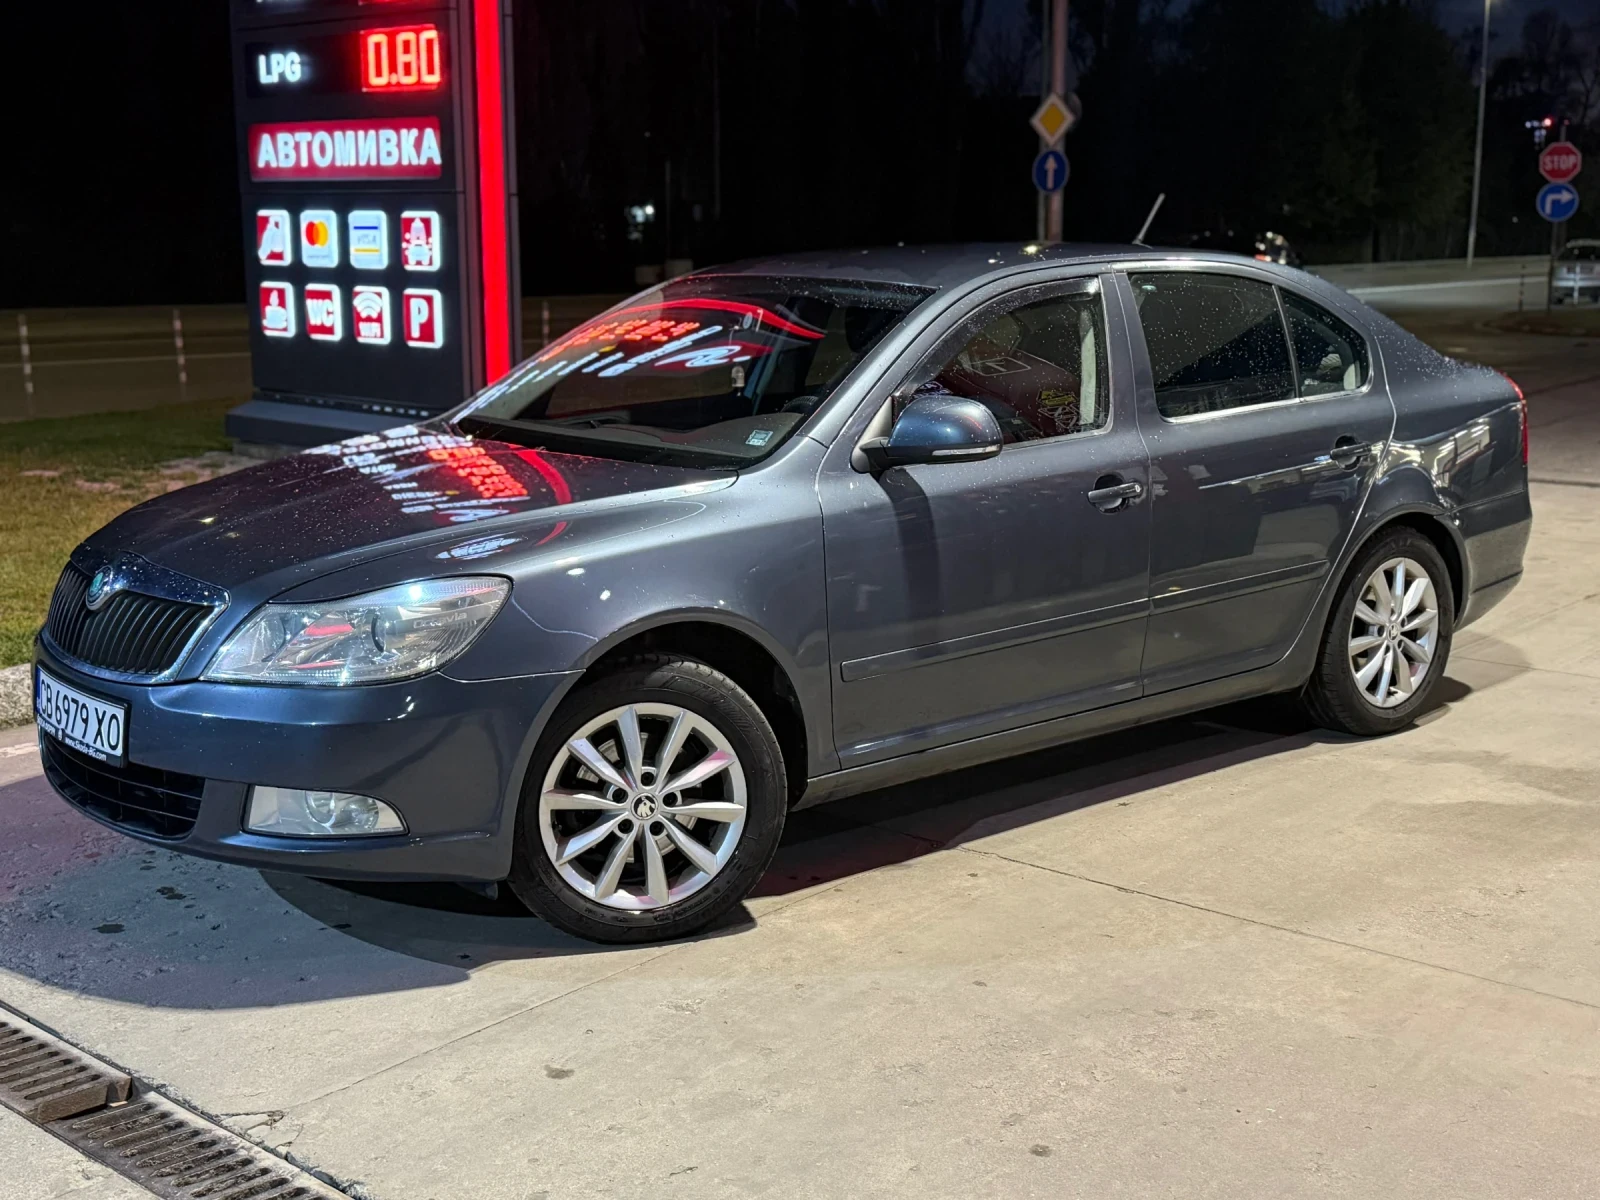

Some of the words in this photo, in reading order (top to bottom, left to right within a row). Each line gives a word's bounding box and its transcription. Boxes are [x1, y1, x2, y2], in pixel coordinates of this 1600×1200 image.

[258, 52, 301, 84] LPG
[367, 30, 441, 86] 0.80
[257, 127, 442, 168] АВТОМИВКА
[1544, 154, 1577, 171] STOP
[306, 298, 334, 327] WC
[409, 297, 429, 339] P
[41, 679, 53, 719] CB
[55, 690, 90, 740] 6979
[93, 707, 121, 751] XO
